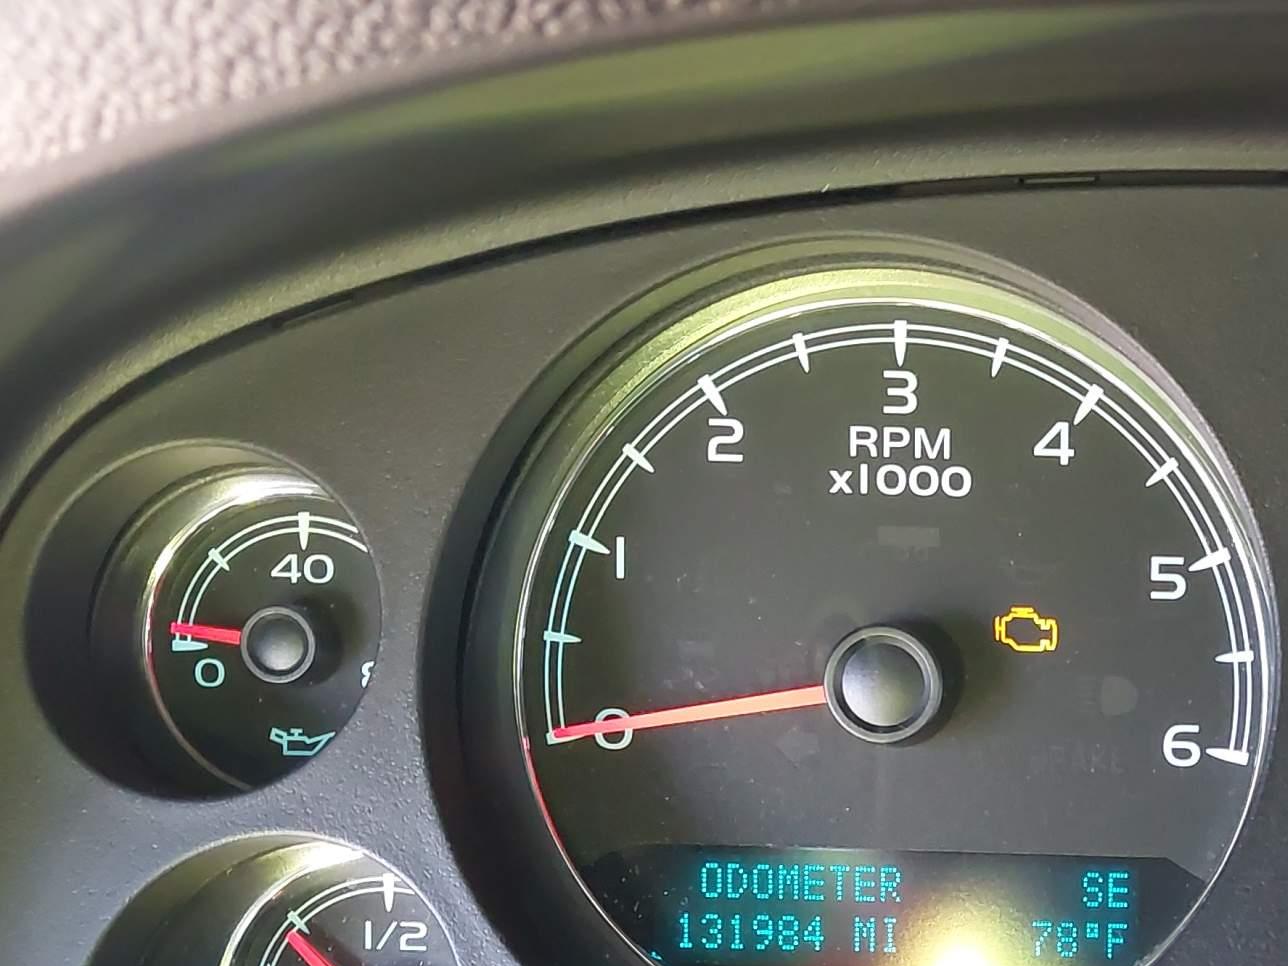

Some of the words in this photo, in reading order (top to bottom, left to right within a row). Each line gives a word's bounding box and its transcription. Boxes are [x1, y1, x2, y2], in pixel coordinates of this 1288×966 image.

[882, 370, 918, 415] 3
[707, 418, 744, 462] 2
[849, 425, 951, 460] RPM
[1033, 419, 1078, 466] 4
[829, 463, 972, 498] x1000
[270, 553, 334, 584] 40
[616, 536, 625, 579] 1
[1150, 556, 1187, 600] 5
[194, 658, 225, 687] 0
[594, 707, 634, 750] 0
[1162, 724, 1201, 767] 6
[701, 862, 901, 903] ODOMETER
[1082, 872, 1128, 908] SE
[364, 918, 430, 952] 1/2
[678, 912, 825, 953] 131984
[854, 916, 899, 955] MI
